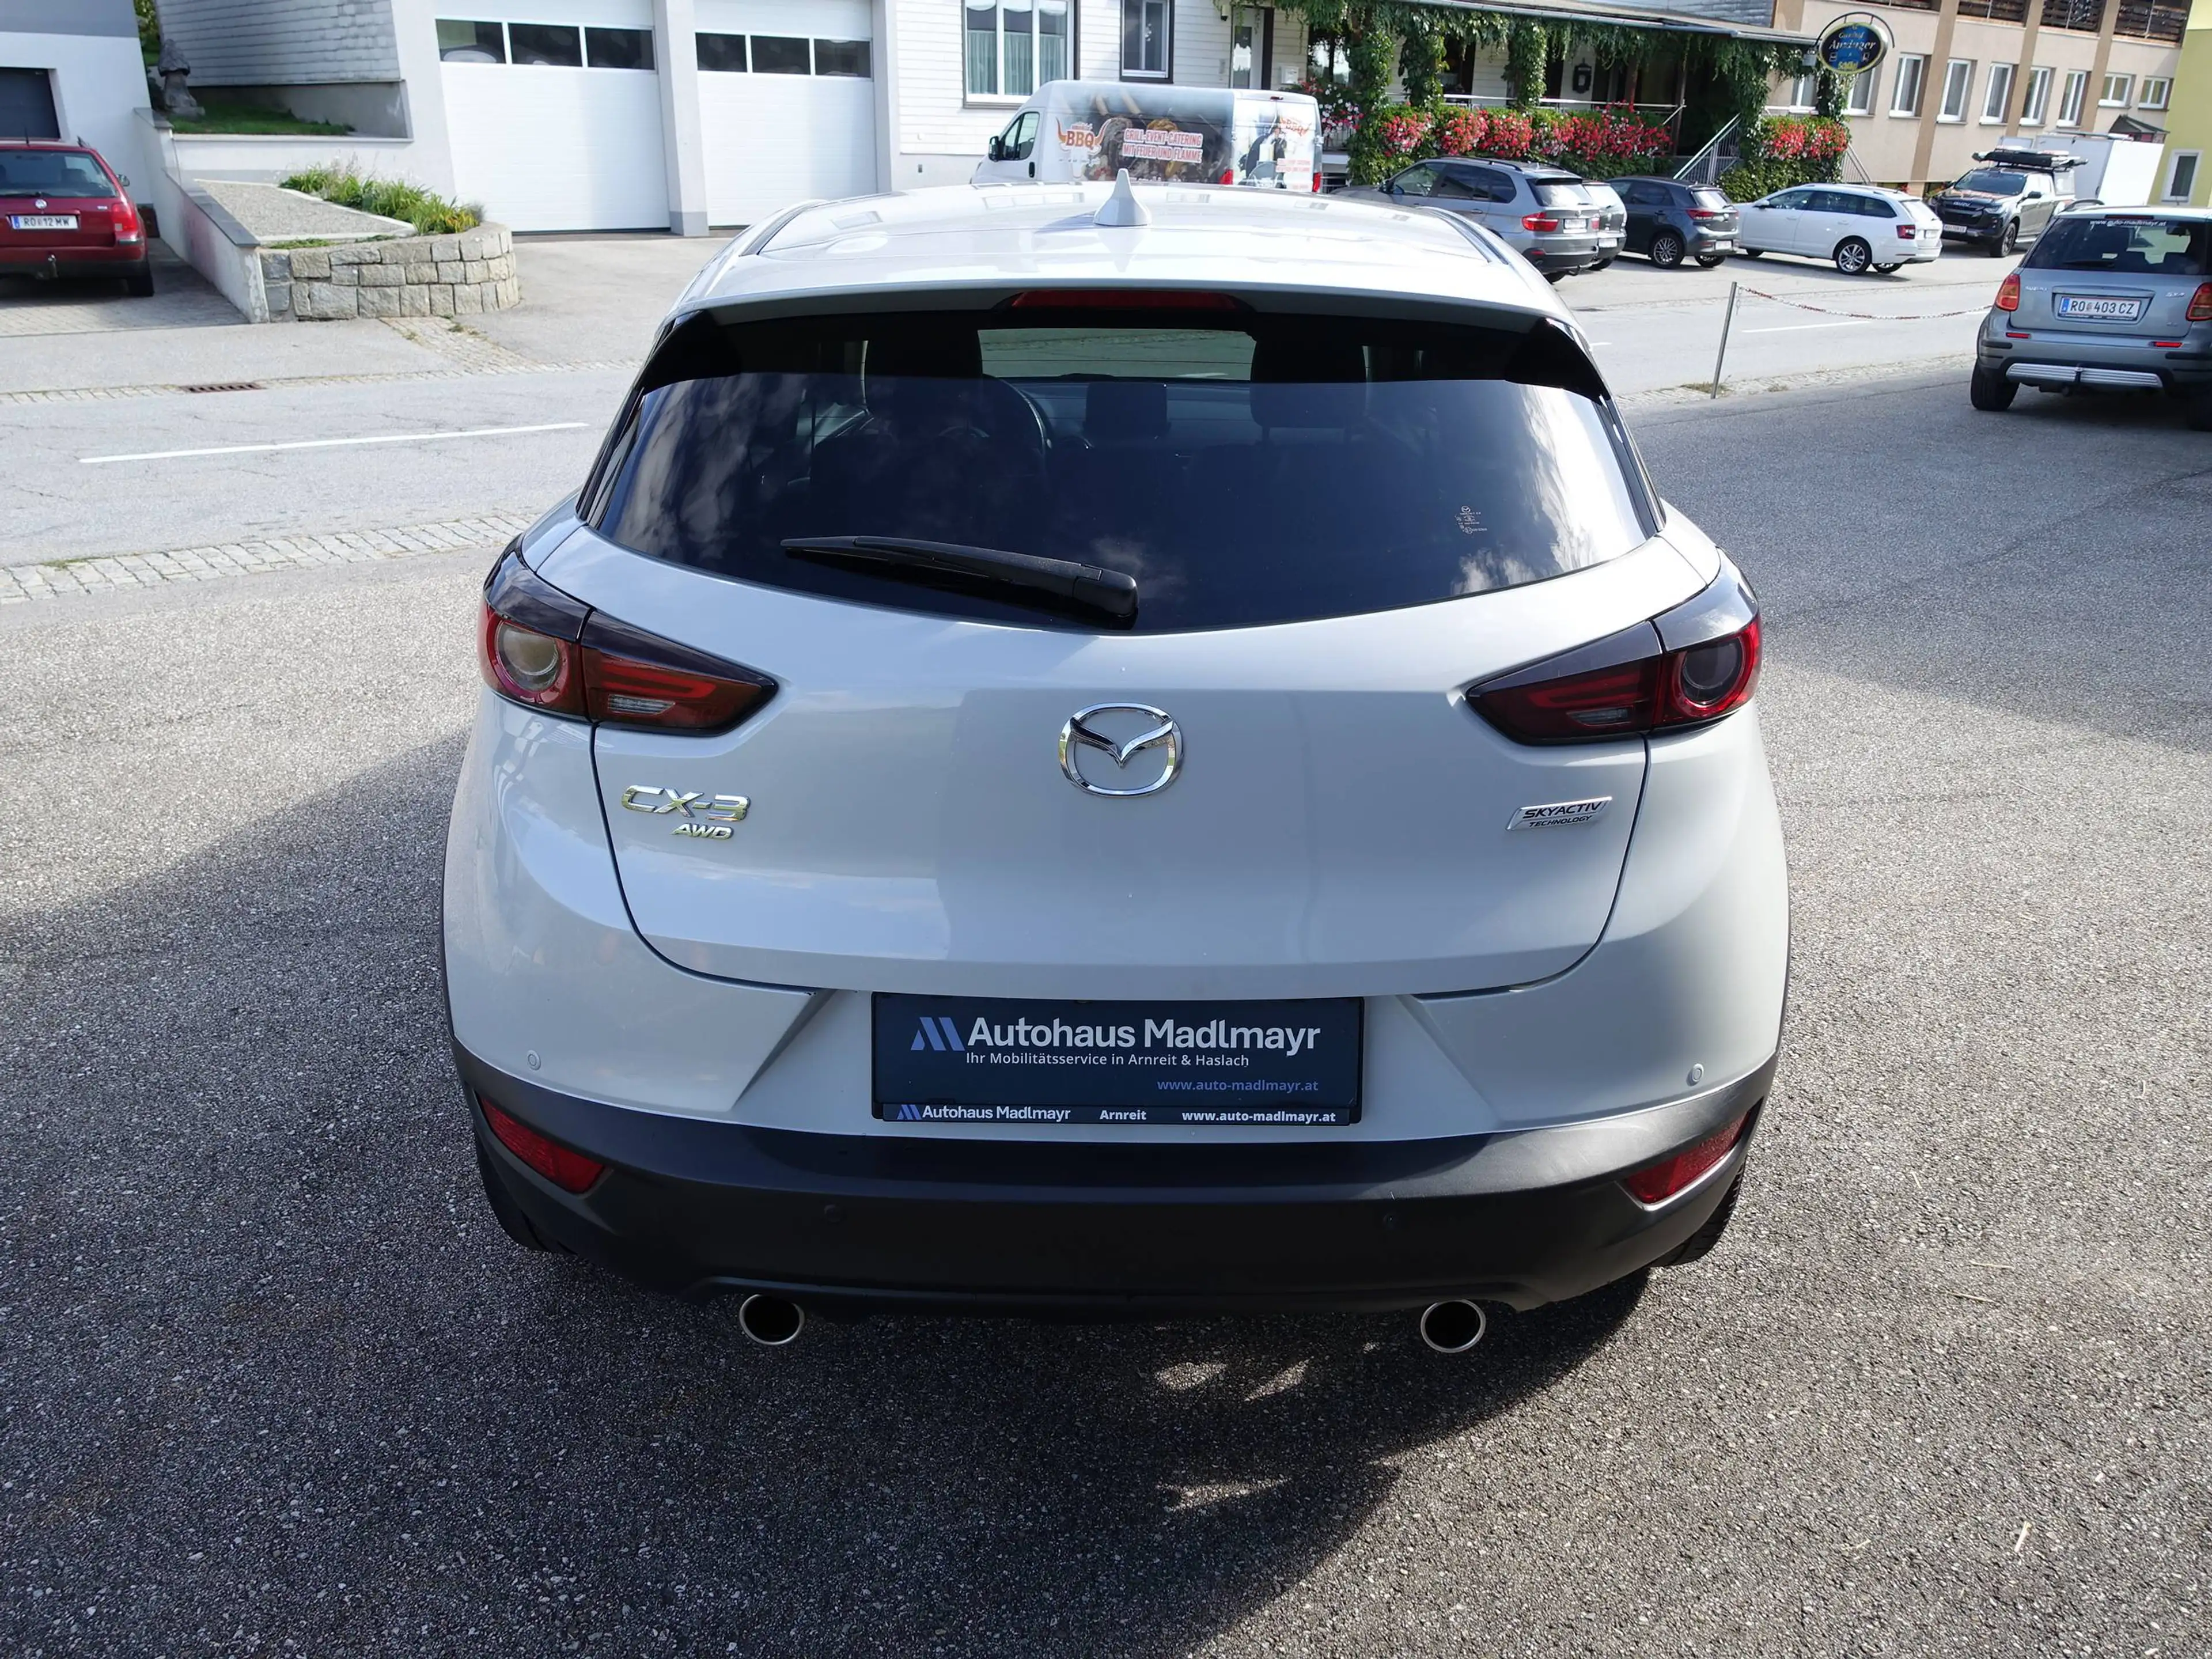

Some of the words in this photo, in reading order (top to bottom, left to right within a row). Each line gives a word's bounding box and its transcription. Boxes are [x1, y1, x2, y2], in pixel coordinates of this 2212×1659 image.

[1066, 130, 1094, 150] BBQ
[1123, 144, 1135, 156] MIT
[1136, 145, 1157, 158] FEUER
[1158, 146, 1172, 160] UND
[24, 217, 36, 226] RO
[43, 217, 54, 226] 12
[2070, 300, 2085, 312] RO
[2093, 302, 2116, 314] 403
[2118, 303, 2135, 315] CZ
[621, 785, 751, 821] CX-3
[1522, 801, 1603, 819] SKYACTIV
[1528, 815, 1593, 828] TECHNOLOGY
[671, 823, 734, 840] AWD
[967, 1017, 1135, 1048] Autohaus
[1144, 1018, 1321, 1056] Madlmayr
[966, 1052, 985, 1064] Ihr
[990, 1052, 1107, 1065] Mobilitätsservice
[1111, 1054, 1124, 1065] in
[1128, 1054, 1177, 1066] Arnreit
[1180, 1055, 1191, 1066] &
[1196, 1054, 1249, 1067] Haslach
[1157, 1080, 1319, 1094] www.auto-madlmayr.at
[922, 1105, 994, 1119] Autohaus
[997, 1105, 1071, 1122] Madlmayr
[1100, 1109, 1147, 1120] Arnreit
[1182, 1111, 1336, 1124] www.auto-madlmayr.at
